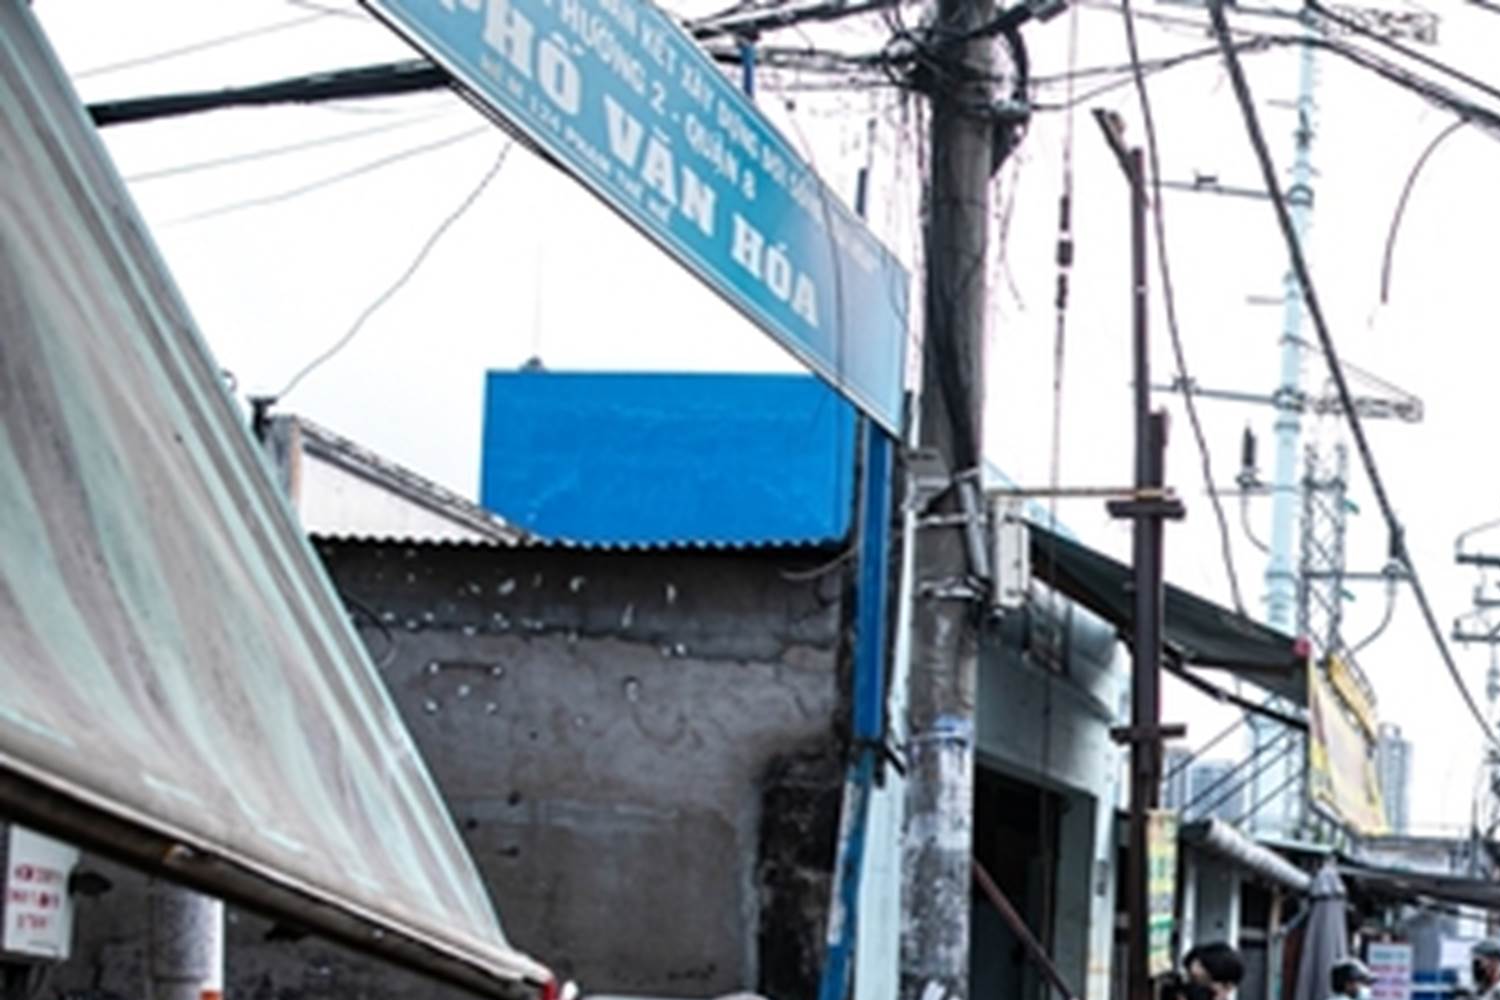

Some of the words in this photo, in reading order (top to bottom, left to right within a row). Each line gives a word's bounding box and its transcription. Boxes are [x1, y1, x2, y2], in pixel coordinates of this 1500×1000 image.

[650, 79, 667, 116] 2
[602, 93, 717, 239] VĂN
[730, 212, 819, 330] HÓA
